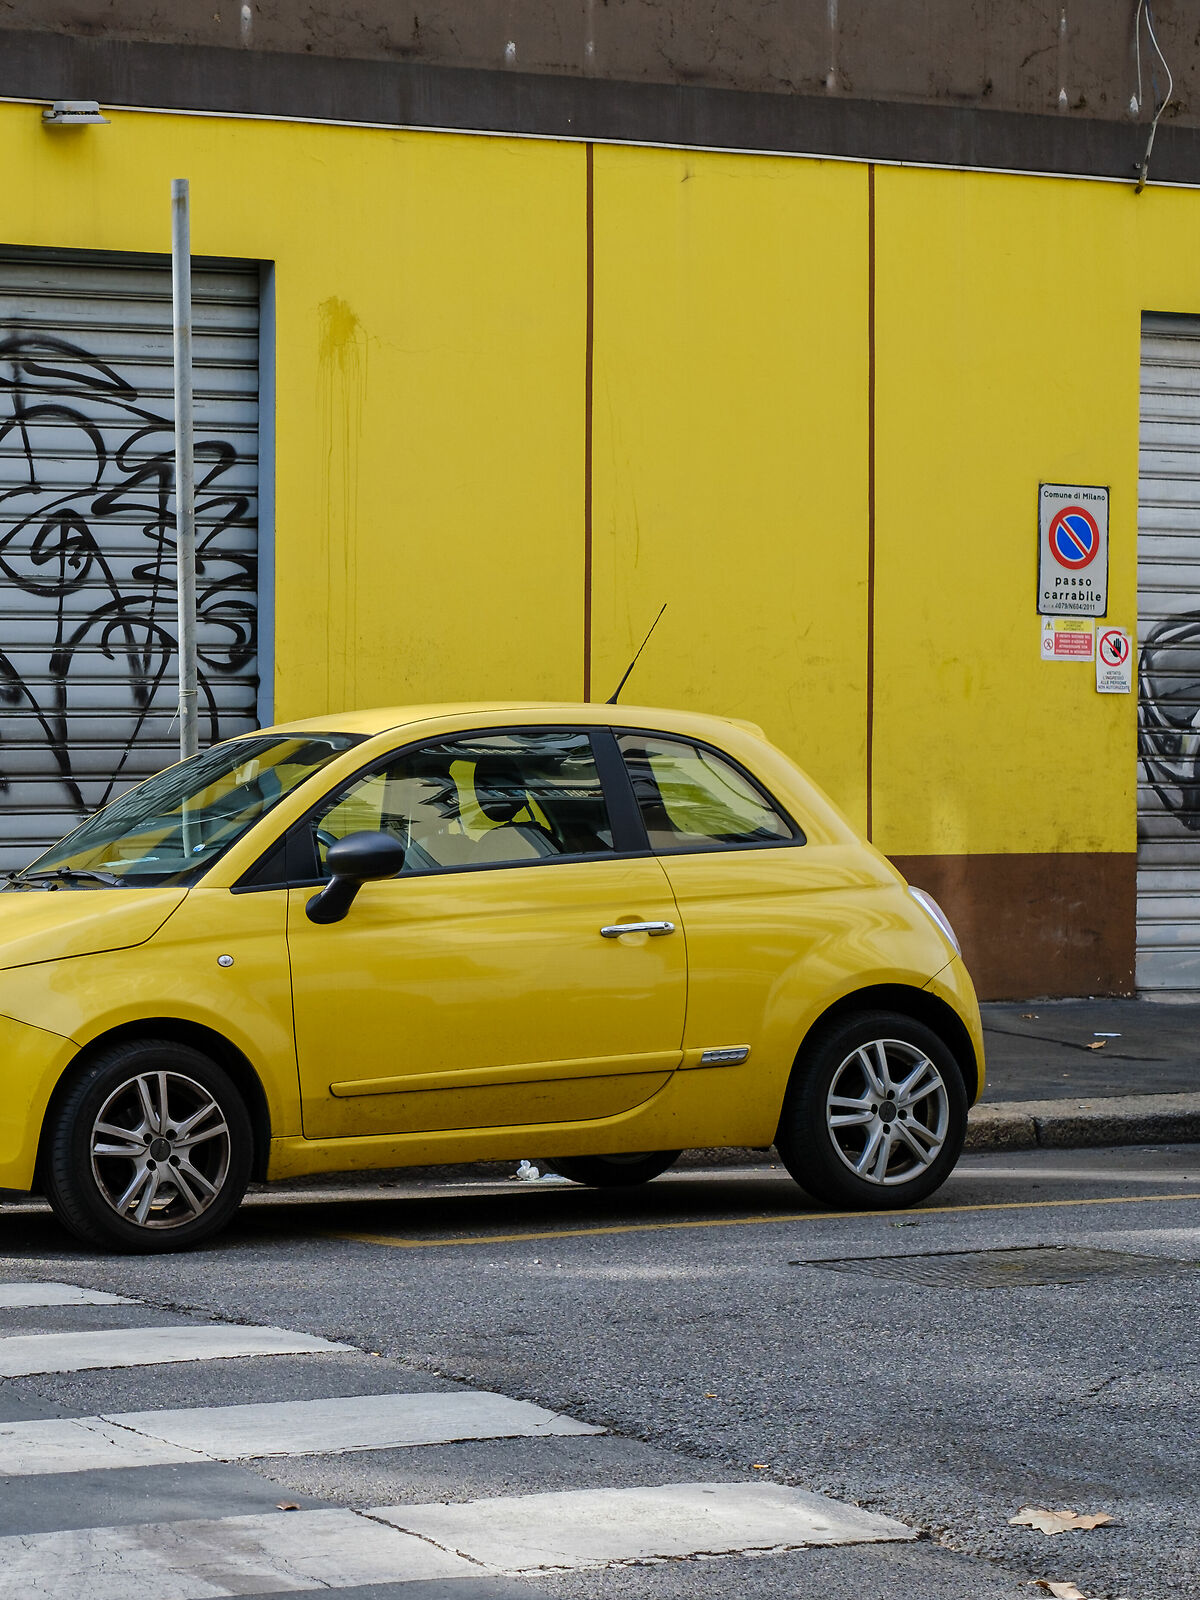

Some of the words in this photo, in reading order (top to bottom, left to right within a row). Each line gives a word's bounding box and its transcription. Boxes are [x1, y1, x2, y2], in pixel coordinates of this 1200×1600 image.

[1043, 490, 1072, 499] Comune
[1074, 492, 1081, 500] di
[1082, 493, 1106, 501] Milano
[1055, 577, 1092, 587] passo
[1044, 591, 1102, 602] carrabile
